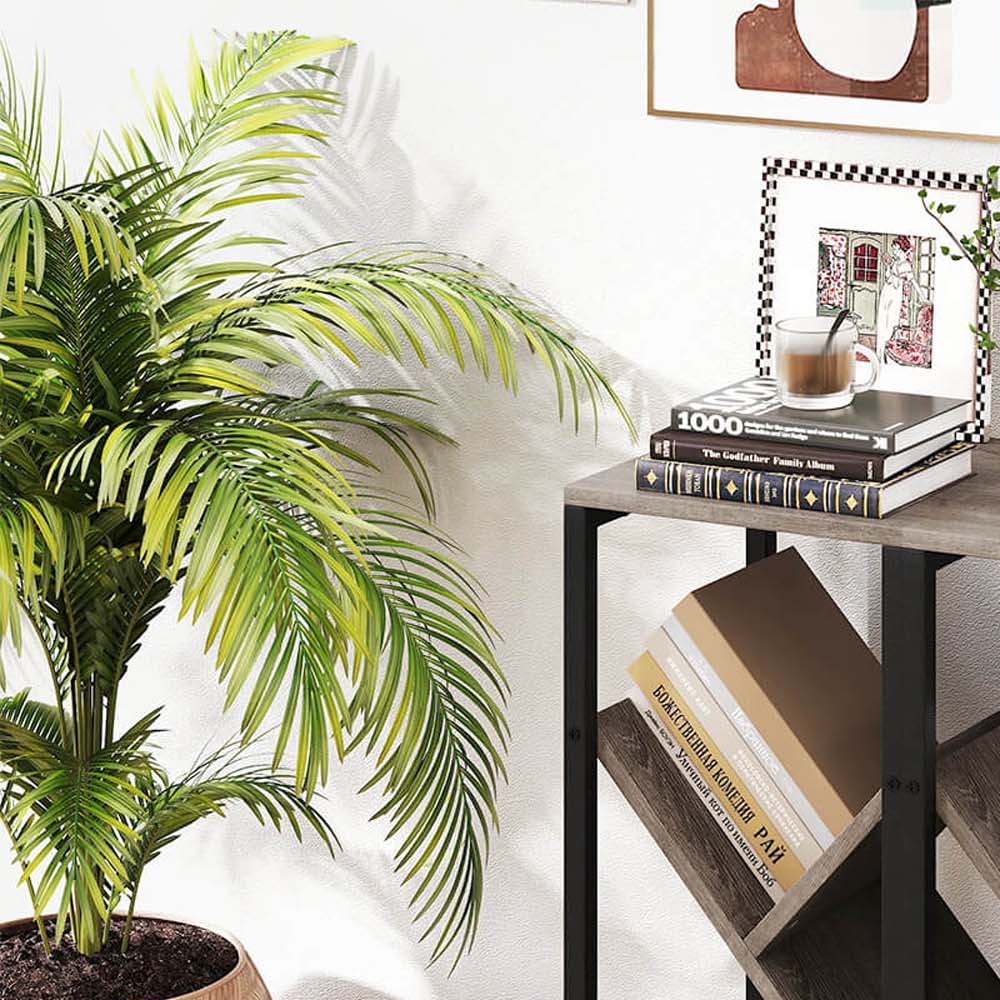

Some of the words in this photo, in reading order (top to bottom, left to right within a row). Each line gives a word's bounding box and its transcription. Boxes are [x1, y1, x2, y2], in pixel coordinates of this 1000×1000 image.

[677, 411, 743, 436] 1000
[702, 448, 721, 459] The
[722, 451, 769, 466] Godfather
[773, 457, 803, 469] Family
[805, 460, 835, 472] Album
[652, 684, 719, 775] БОЖЕСТВЕННАЯ
[711, 767, 757, 824] КОМЕДИЯ
[753, 826, 788, 865] РАЙ
[674, 747, 712, 800] Уличный
[708, 795, 725, 818] кот
[757, 862, 776, 888] Боб
